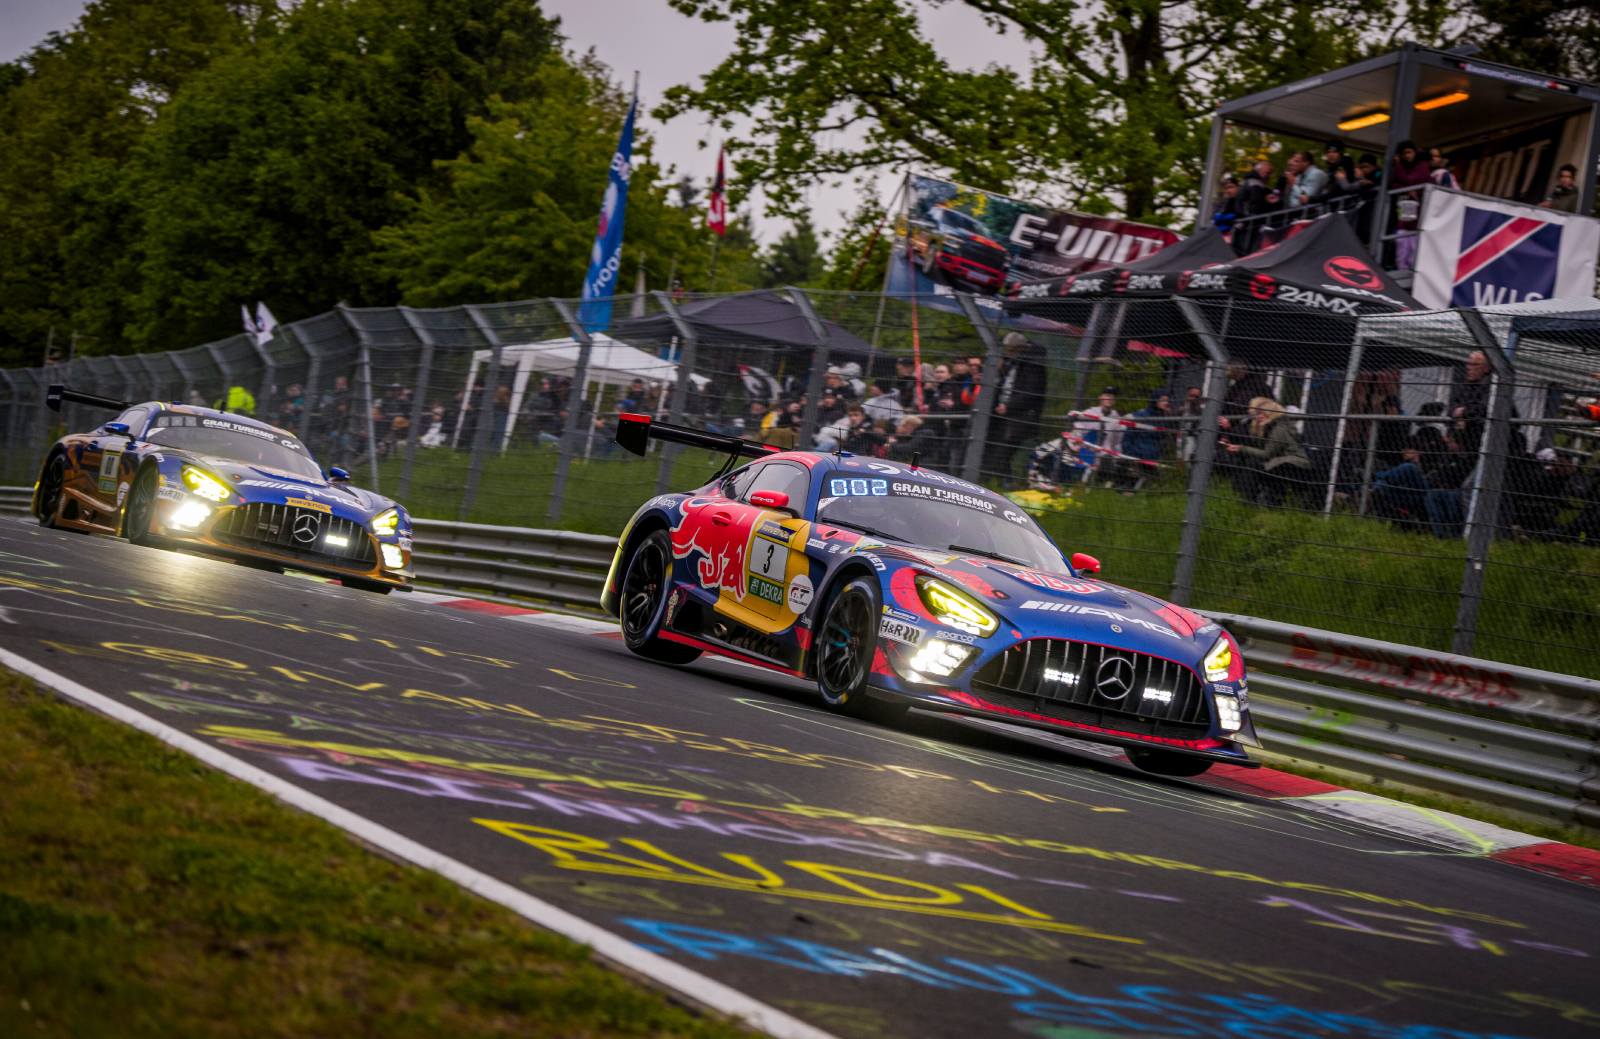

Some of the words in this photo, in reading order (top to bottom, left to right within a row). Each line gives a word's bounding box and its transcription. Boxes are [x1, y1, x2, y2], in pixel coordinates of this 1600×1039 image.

[1277, 285, 1360, 316] 24MX
[203, 419, 231, 429] GRAN
[232, 423, 275, 440] TURISMO
[892, 482, 931, 496] GRAN
[934, 488, 993, 510] TURISMO
[763, 544, 775, 574] 3
[760, 581, 784, 604] DEKRA
[880, 618, 903, 638] H&R
[935, 630, 975, 644] sparco
[465, 816, 1054, 920] RUDI
